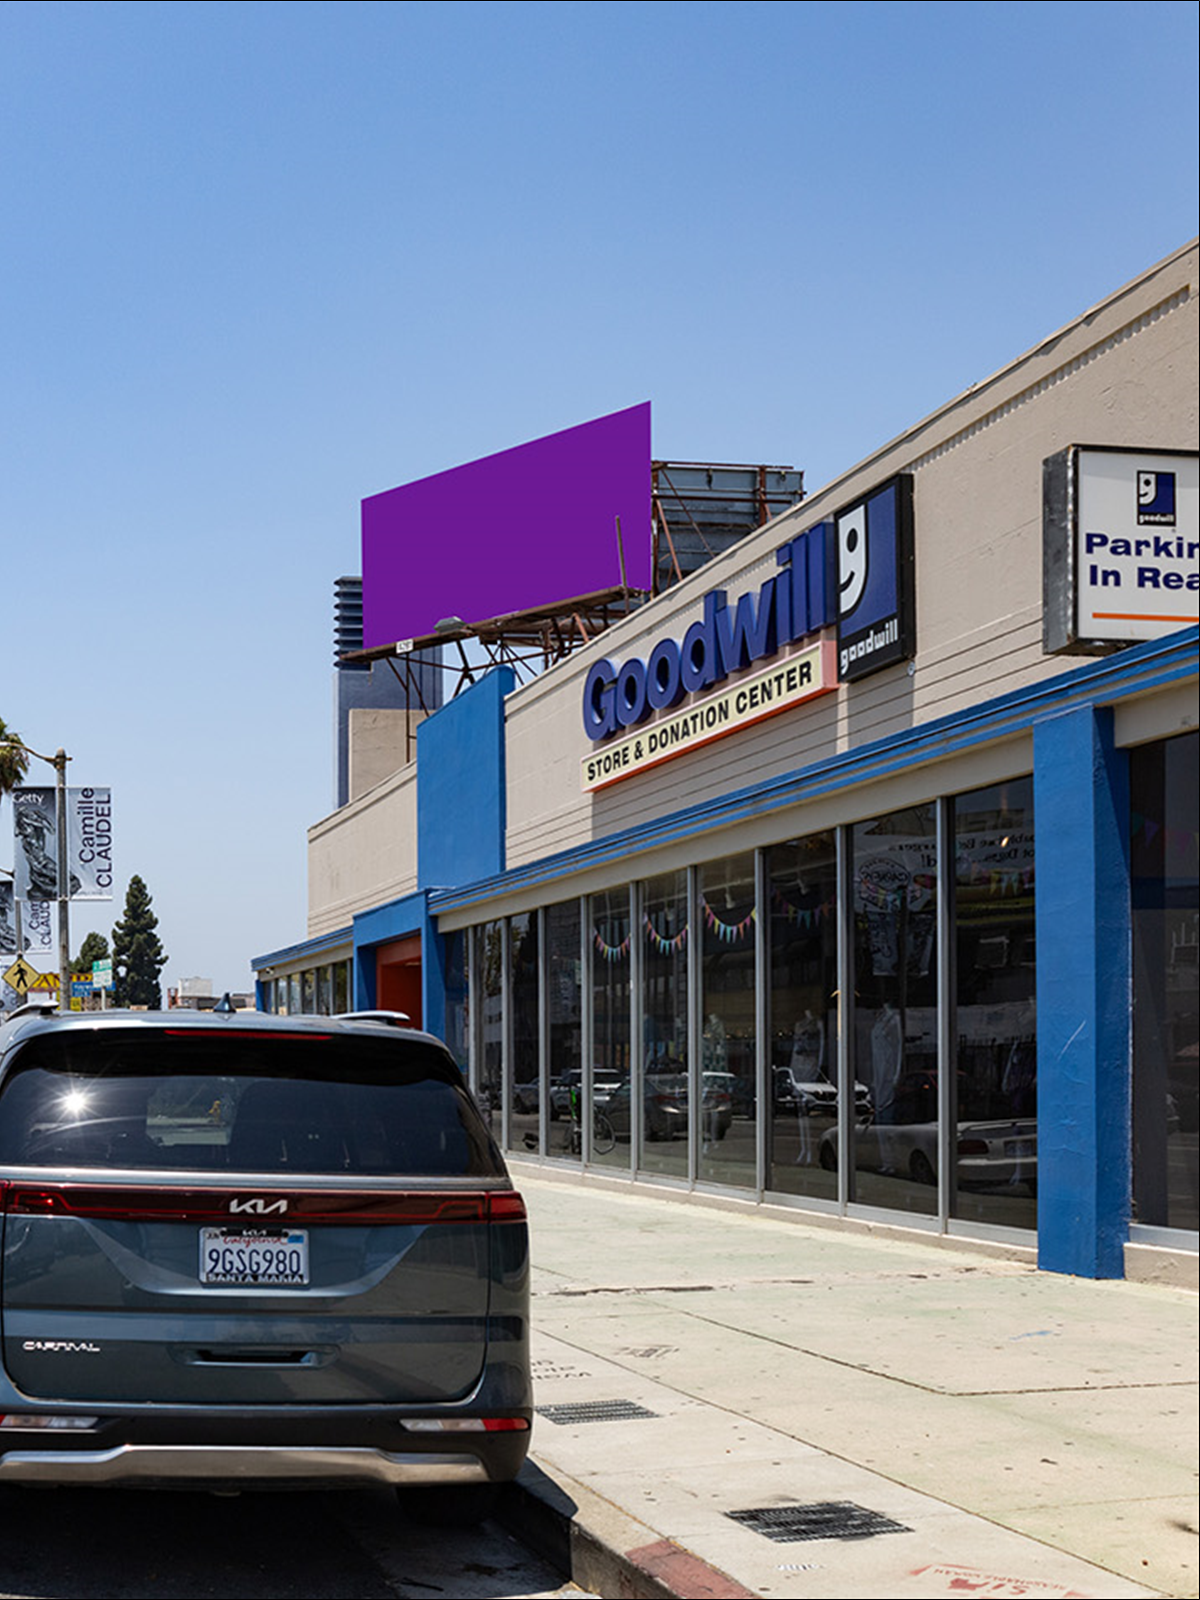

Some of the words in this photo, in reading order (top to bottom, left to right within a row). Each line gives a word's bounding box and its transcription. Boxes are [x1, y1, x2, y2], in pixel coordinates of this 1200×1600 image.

[1089, 564, 1121, 587] In
[582, 522, 835, 741] Goodwill
[840, 618, 898, 676] goodwill
[587, 750, 630, 782] STORE
[633, 740, 644, 760] &
[648, 699, 729, 754] DONATION
[735, 660, 812, 715] CENTER
[77, 787, 95, 863] Camille
[95, 794, 112, 888] CLAUDEL
[229, 1199, 288, 1214] KIA
[208, 1248, 301, 1275] 9GSG980
